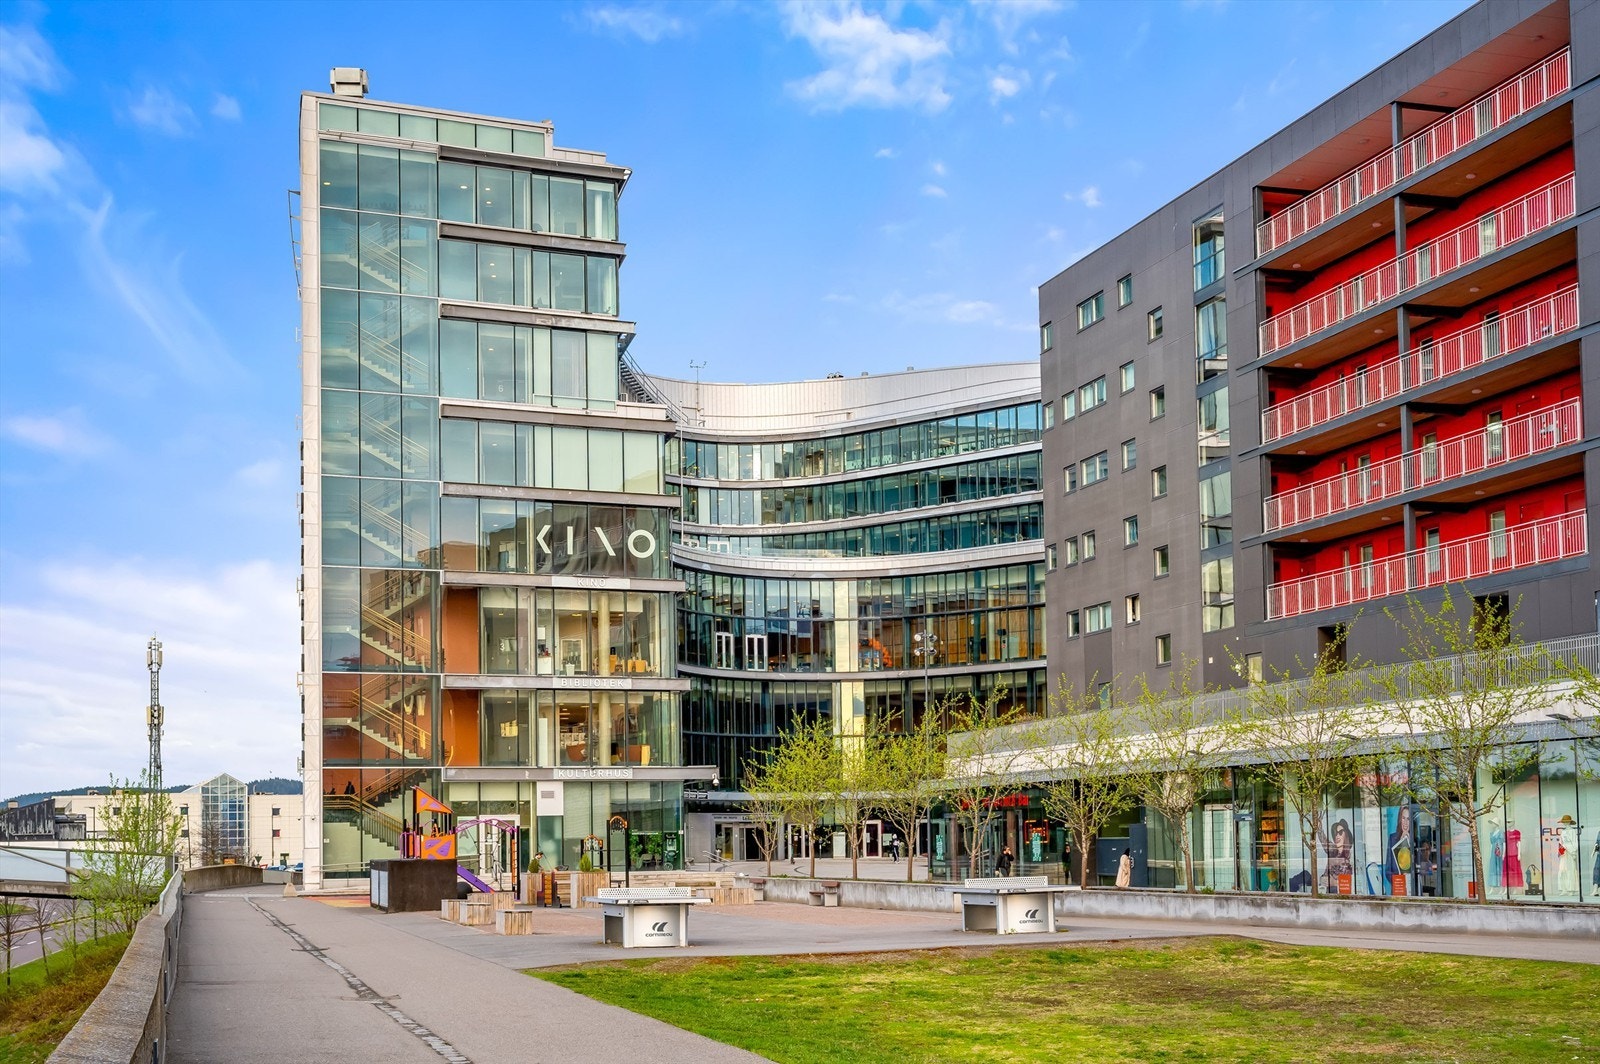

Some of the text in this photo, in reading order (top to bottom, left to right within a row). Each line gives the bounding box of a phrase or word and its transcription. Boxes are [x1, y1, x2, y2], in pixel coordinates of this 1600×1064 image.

[536, 524, 656, 559] KINO
[577, 578, 606, 587] KINO
[561, 678, 625, 688] BIBLIOTEK
[558, 769, 630, 778] KULTURHUS
